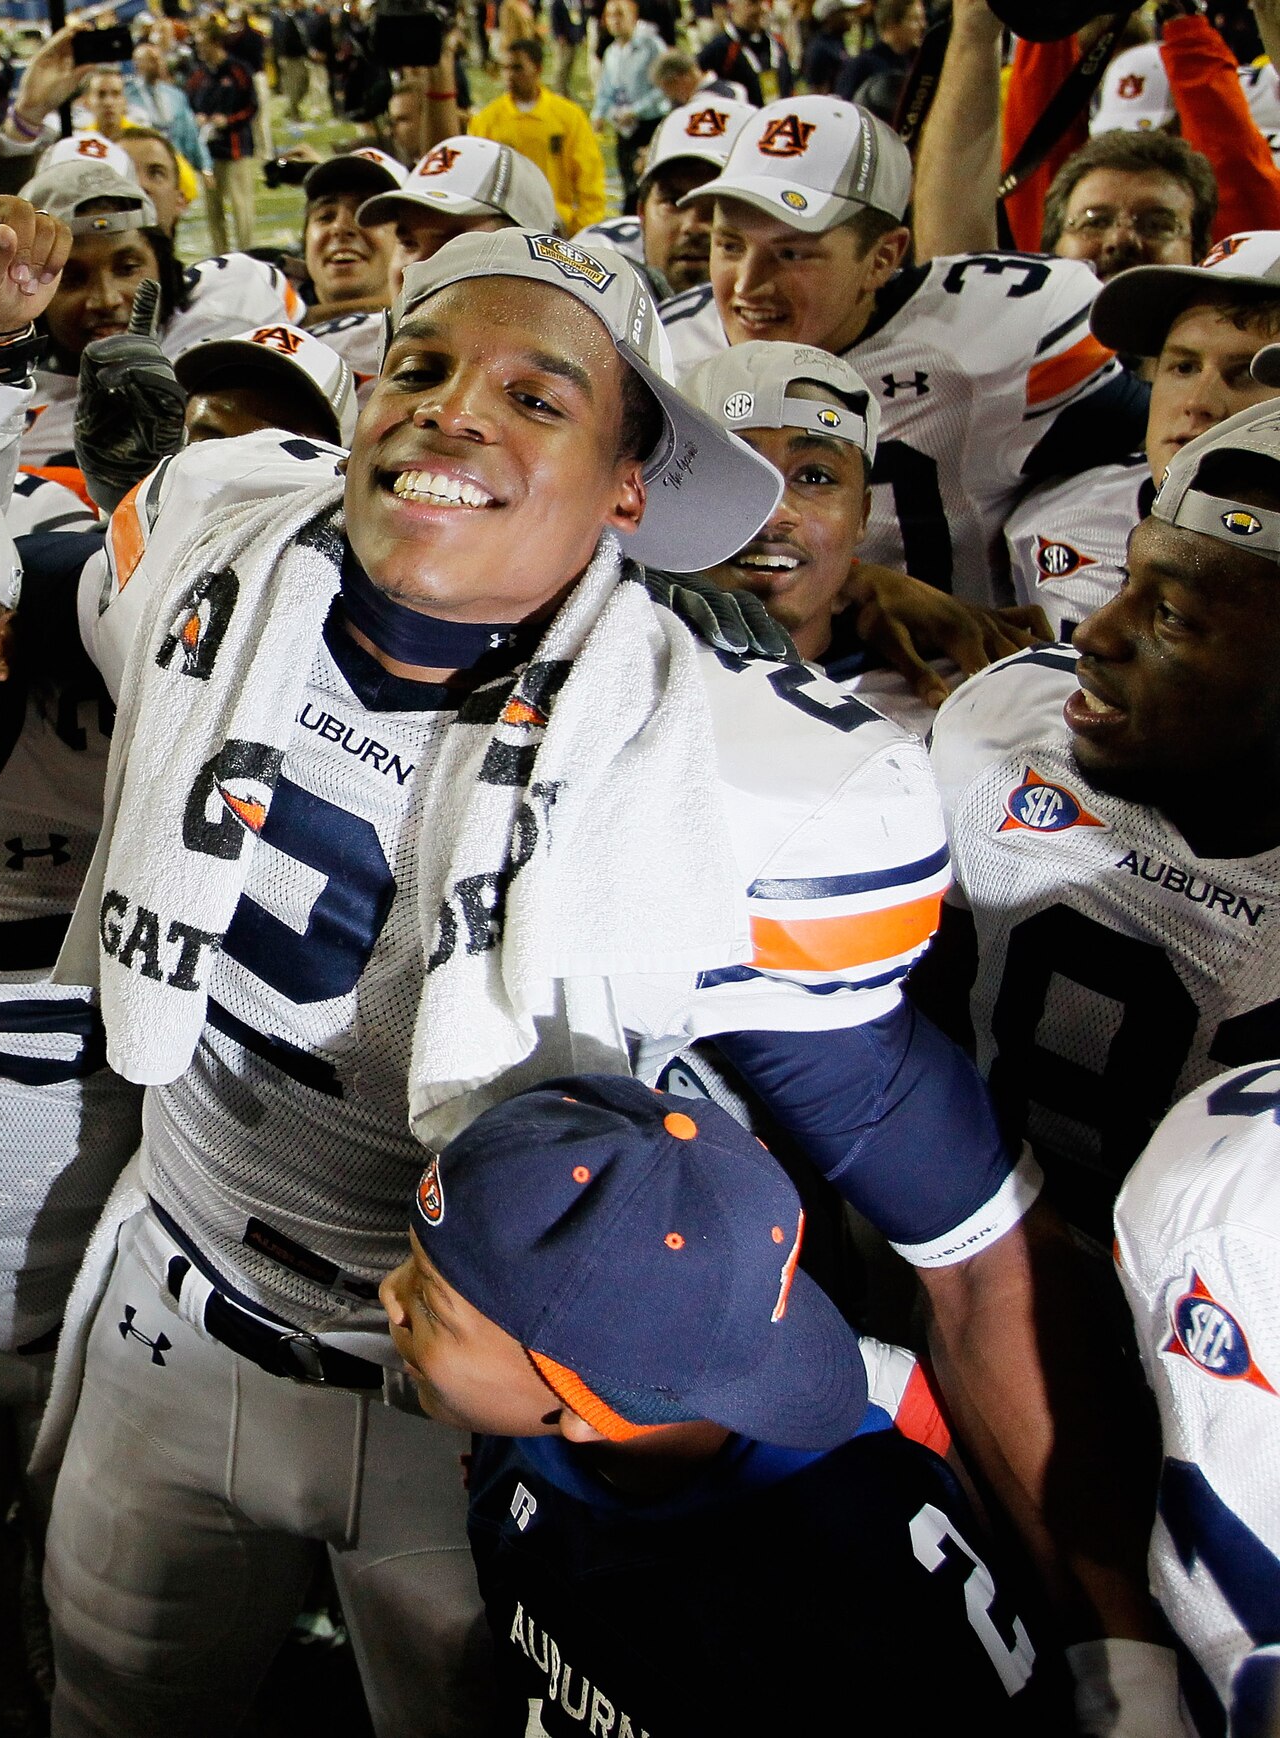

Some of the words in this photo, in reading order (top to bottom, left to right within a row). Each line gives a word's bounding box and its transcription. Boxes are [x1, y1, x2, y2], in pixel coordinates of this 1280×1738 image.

[631, 297, 647, 345] 2010
[724, 391, 754, 420] SEC
[1040, 542, 1076, 573] SEC
[293, 702, 416, 786] UBURN
[1019, 783, 1066, 830] SEC
[1115, 849, 1266, 927] AUBURN
[1183, 1301, 1235, 1370] SEC
[909, 1502, 1037, 1698] 2
